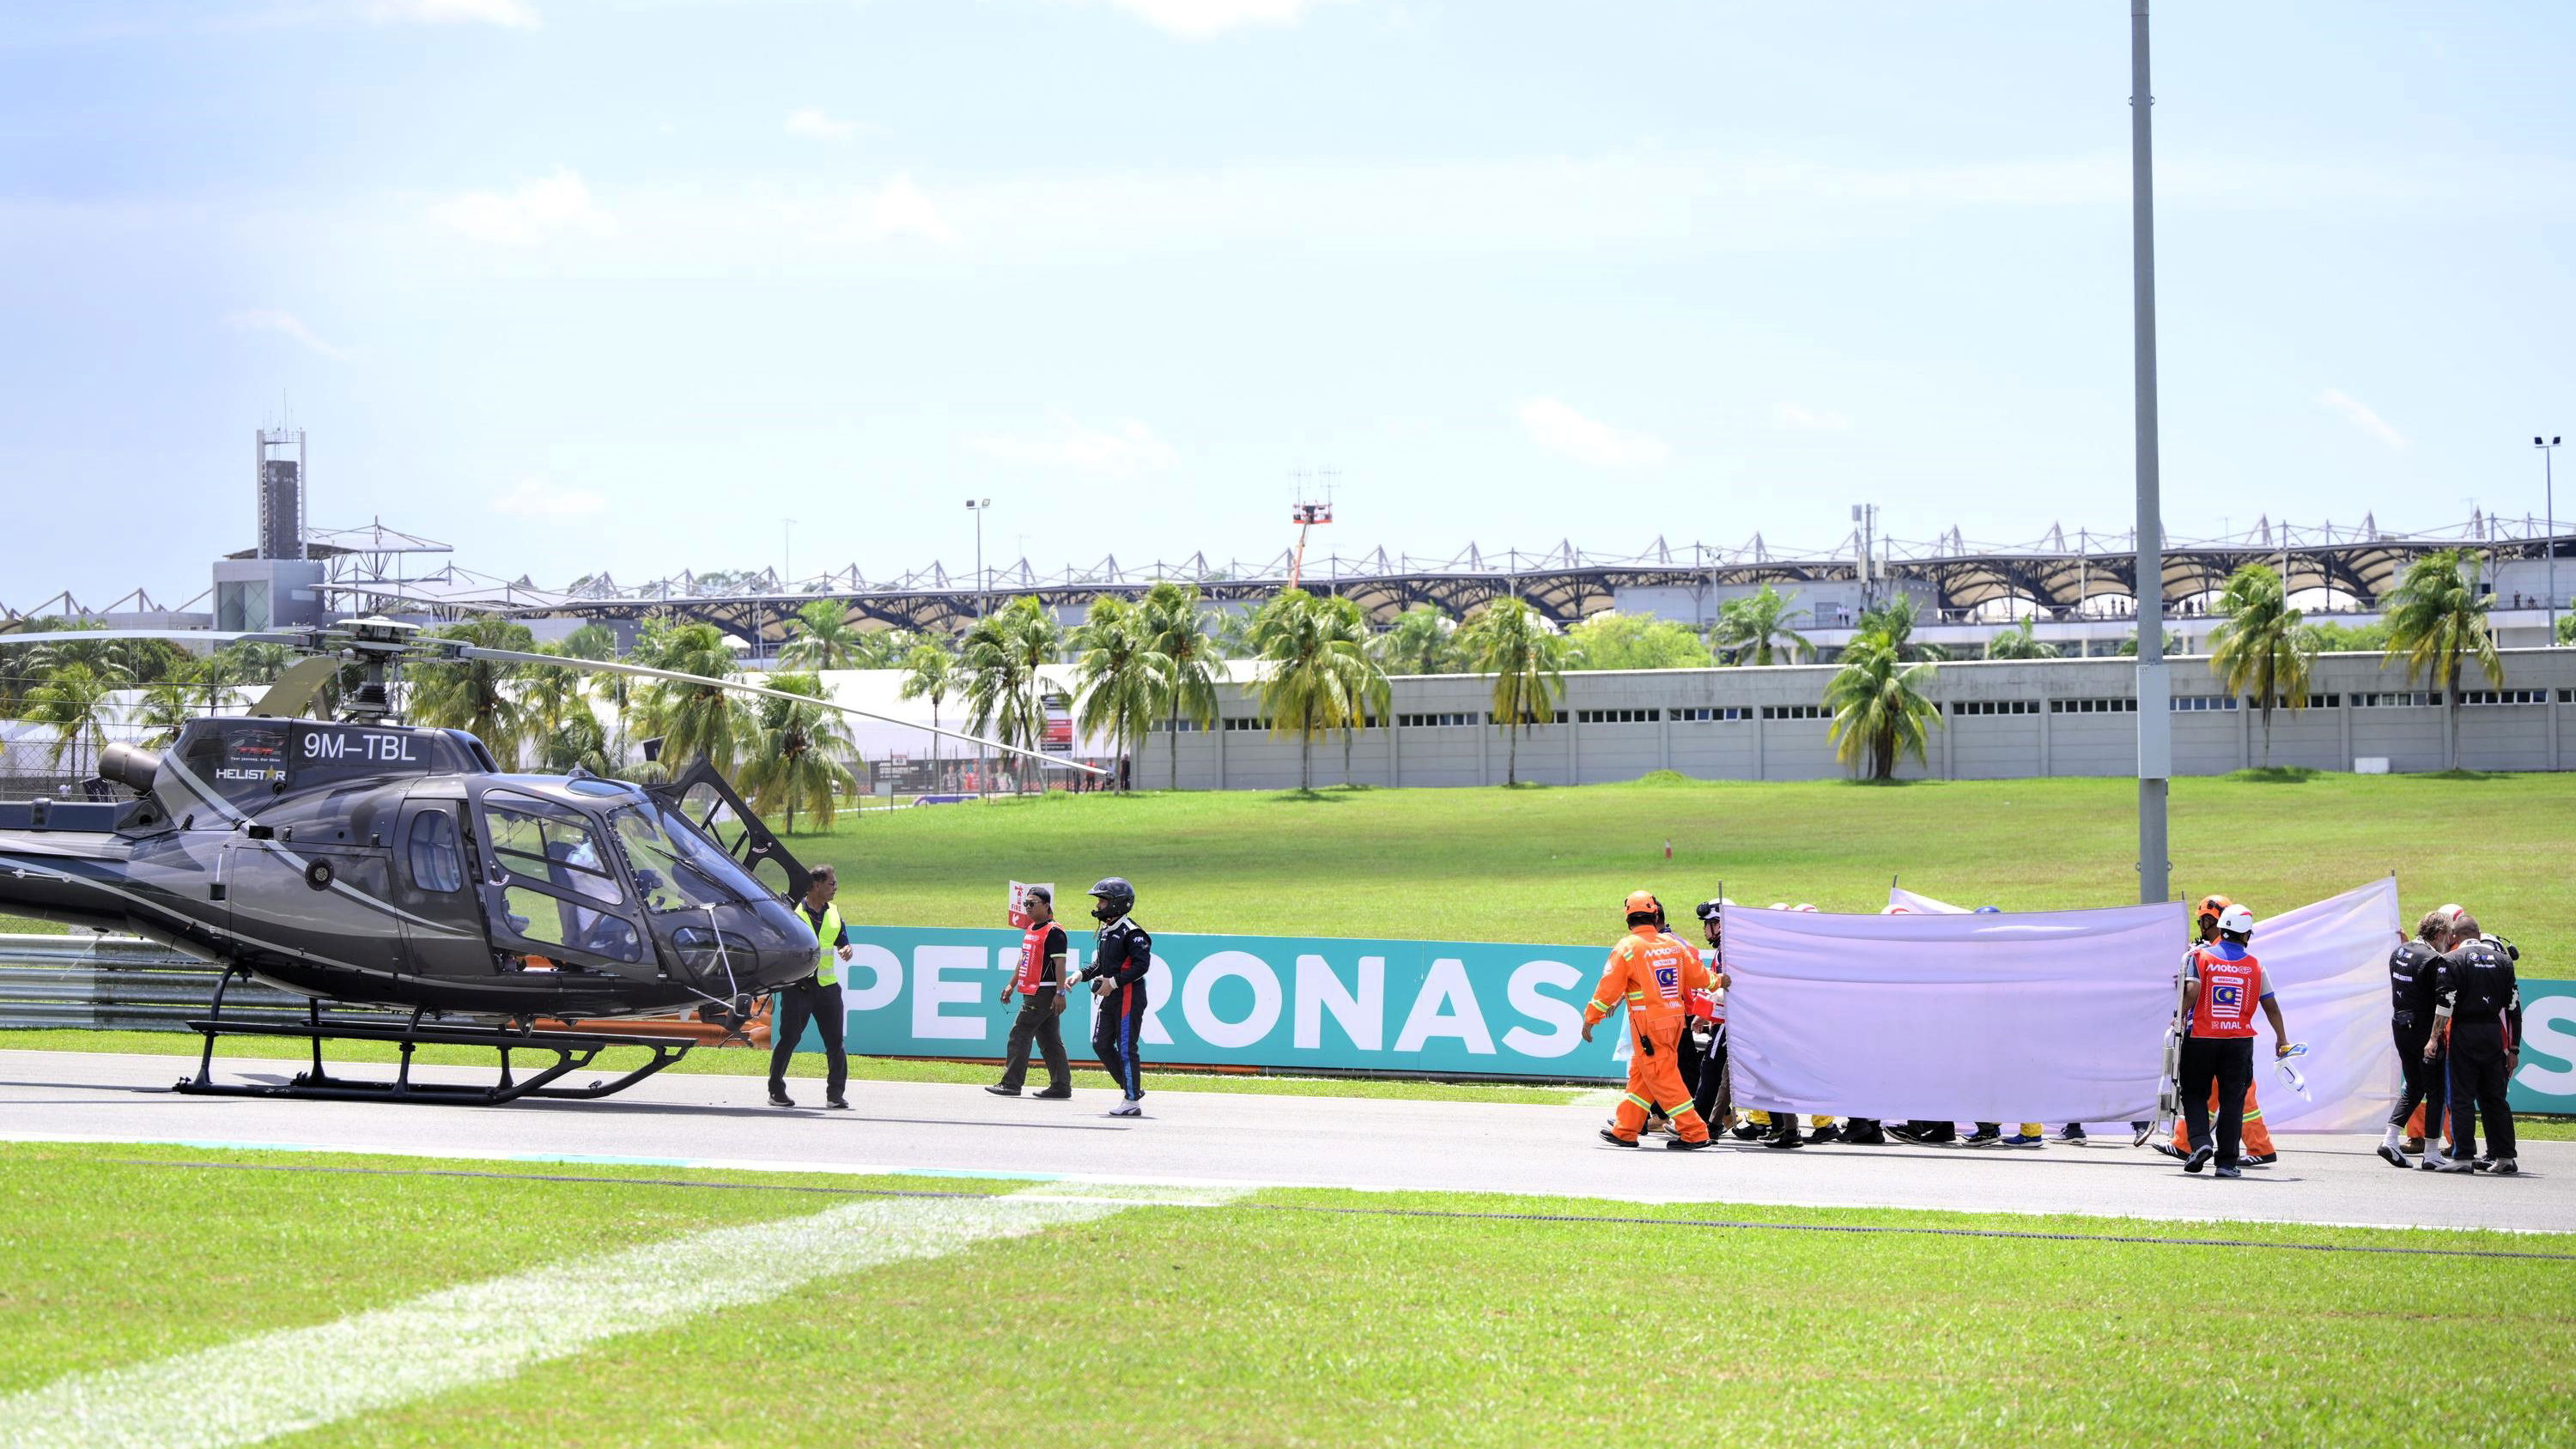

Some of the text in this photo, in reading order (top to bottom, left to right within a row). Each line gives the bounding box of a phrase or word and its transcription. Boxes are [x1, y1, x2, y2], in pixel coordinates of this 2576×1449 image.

[304, 733, 416, 761] 9M-TBL
[2205, 963, 2252, 974] MotoGP
[833, 944, 1583, 1058] PERONAS
